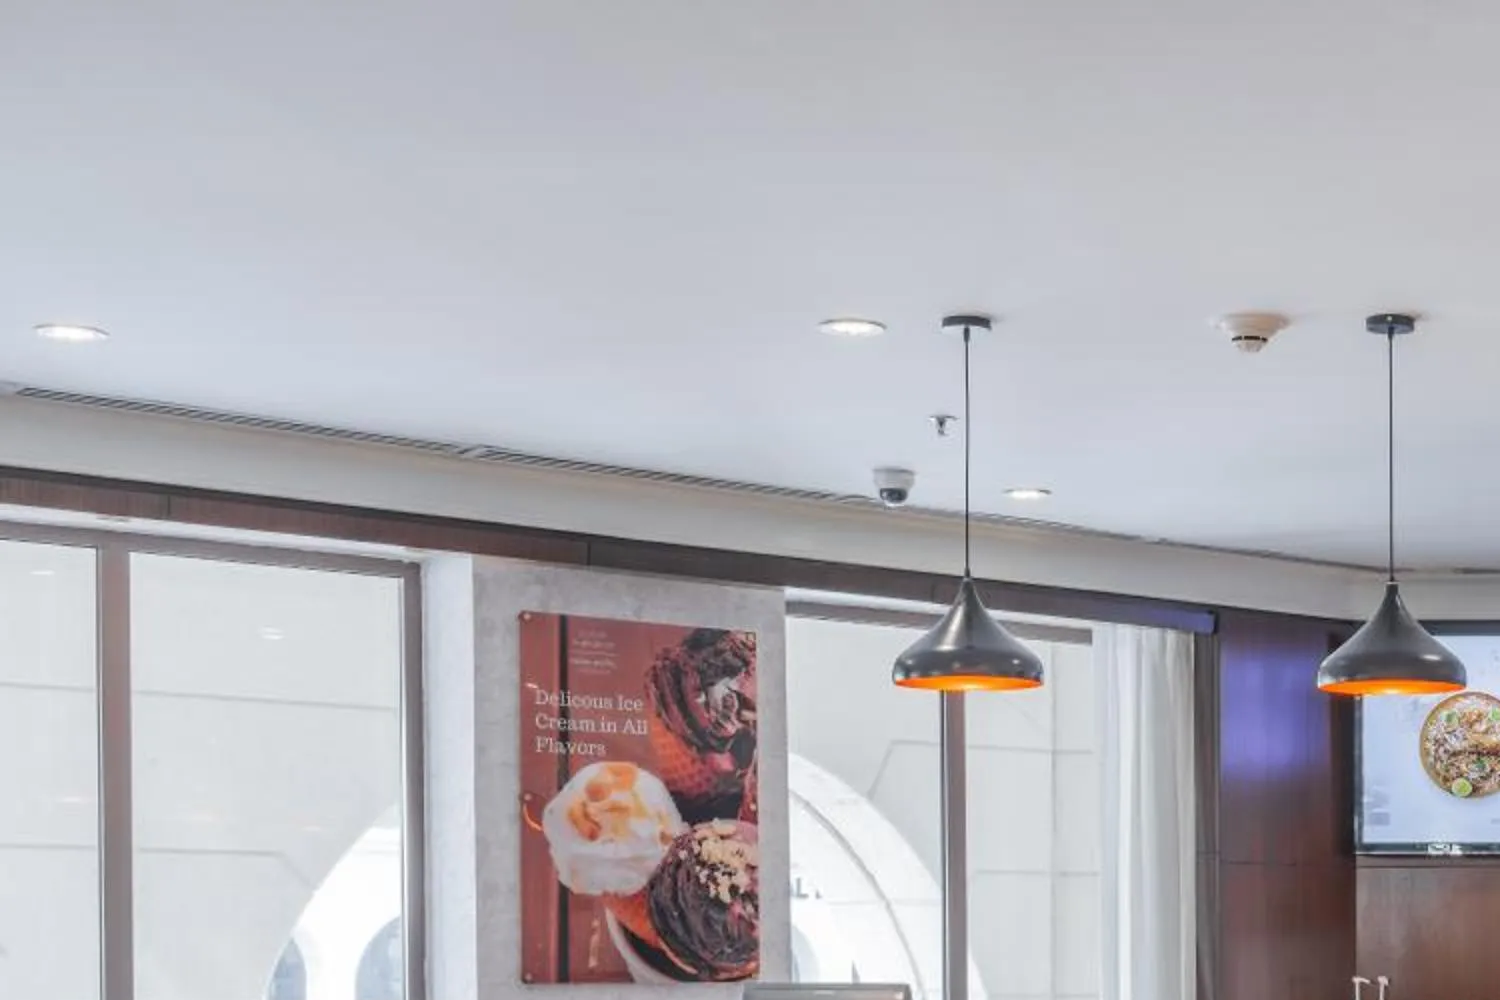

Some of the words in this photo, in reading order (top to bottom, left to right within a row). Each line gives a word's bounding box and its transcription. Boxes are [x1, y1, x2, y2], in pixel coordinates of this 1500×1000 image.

[617, 693, 644, 712] Ice
[535, 712, 596, 733] Cream
[600, 715, 618, 733] in
[622, 718, 648, 735] All
[535, 734, 607, 757] Flavors
